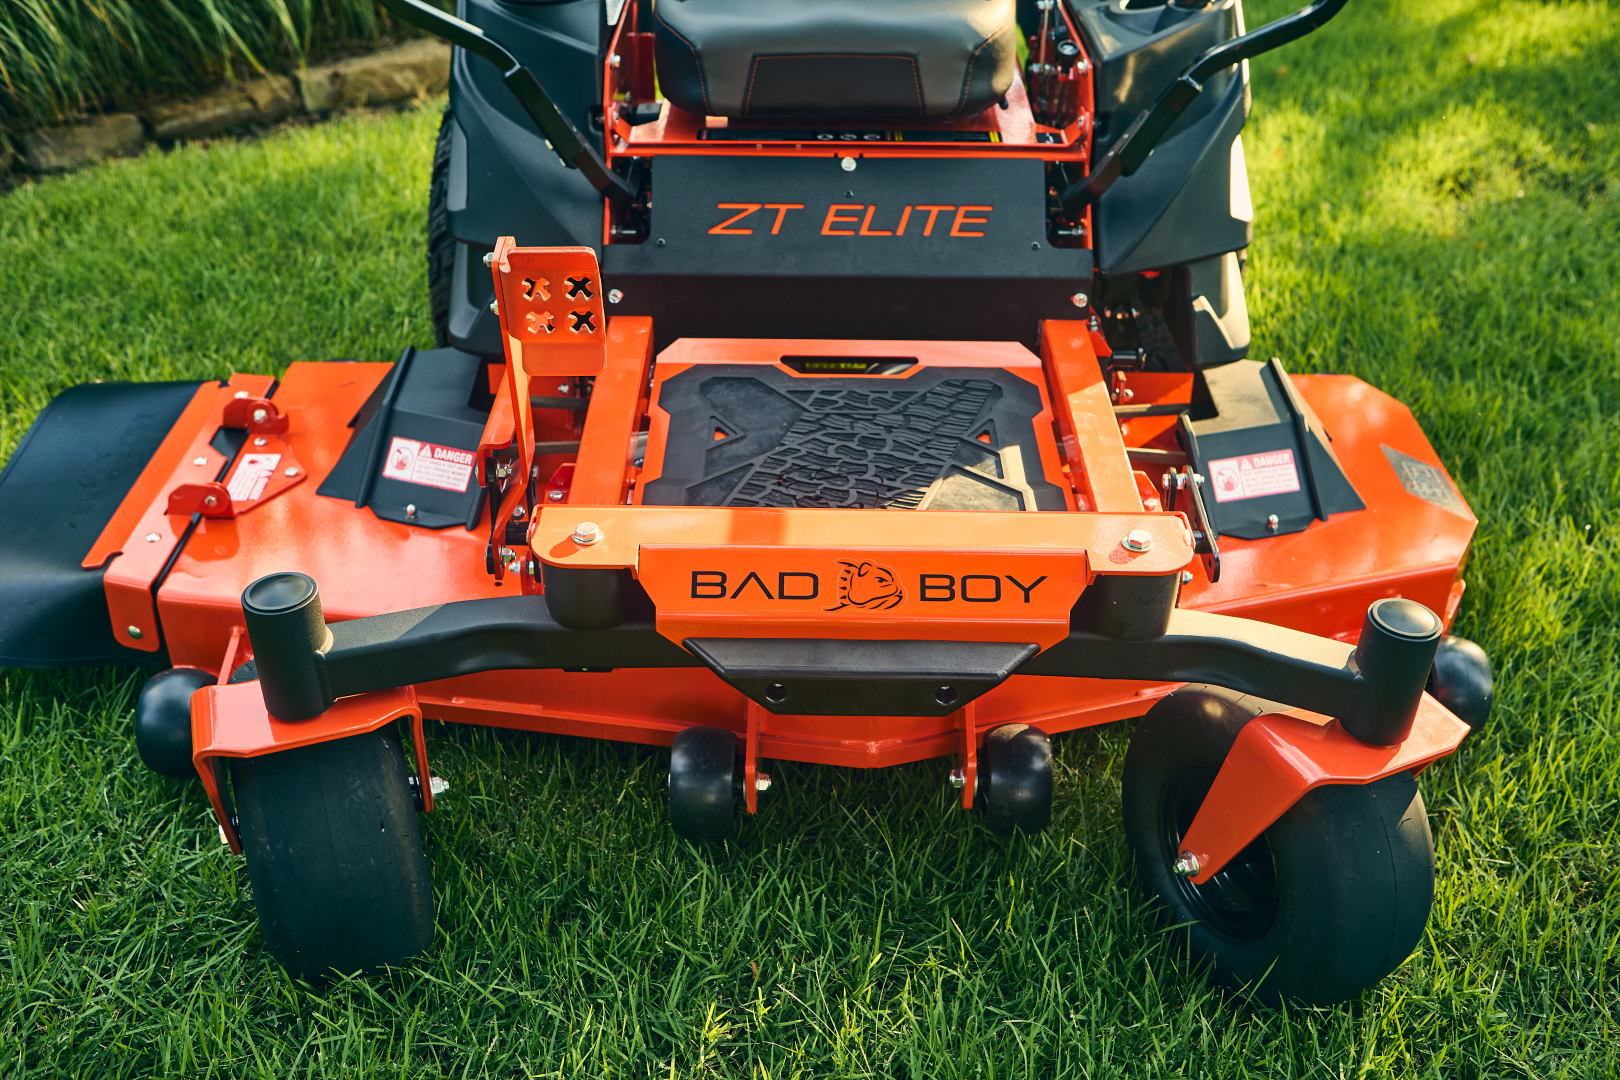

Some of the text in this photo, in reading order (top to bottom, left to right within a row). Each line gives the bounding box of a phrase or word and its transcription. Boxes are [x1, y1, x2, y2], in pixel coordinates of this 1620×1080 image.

[708, 203, 993, 237] ZT ELITE
[434, 448, 473, 464] DANGER
[1253, 453, 1291, 468] DANGER
[691, 571, 1048, 604] BAD BOY
